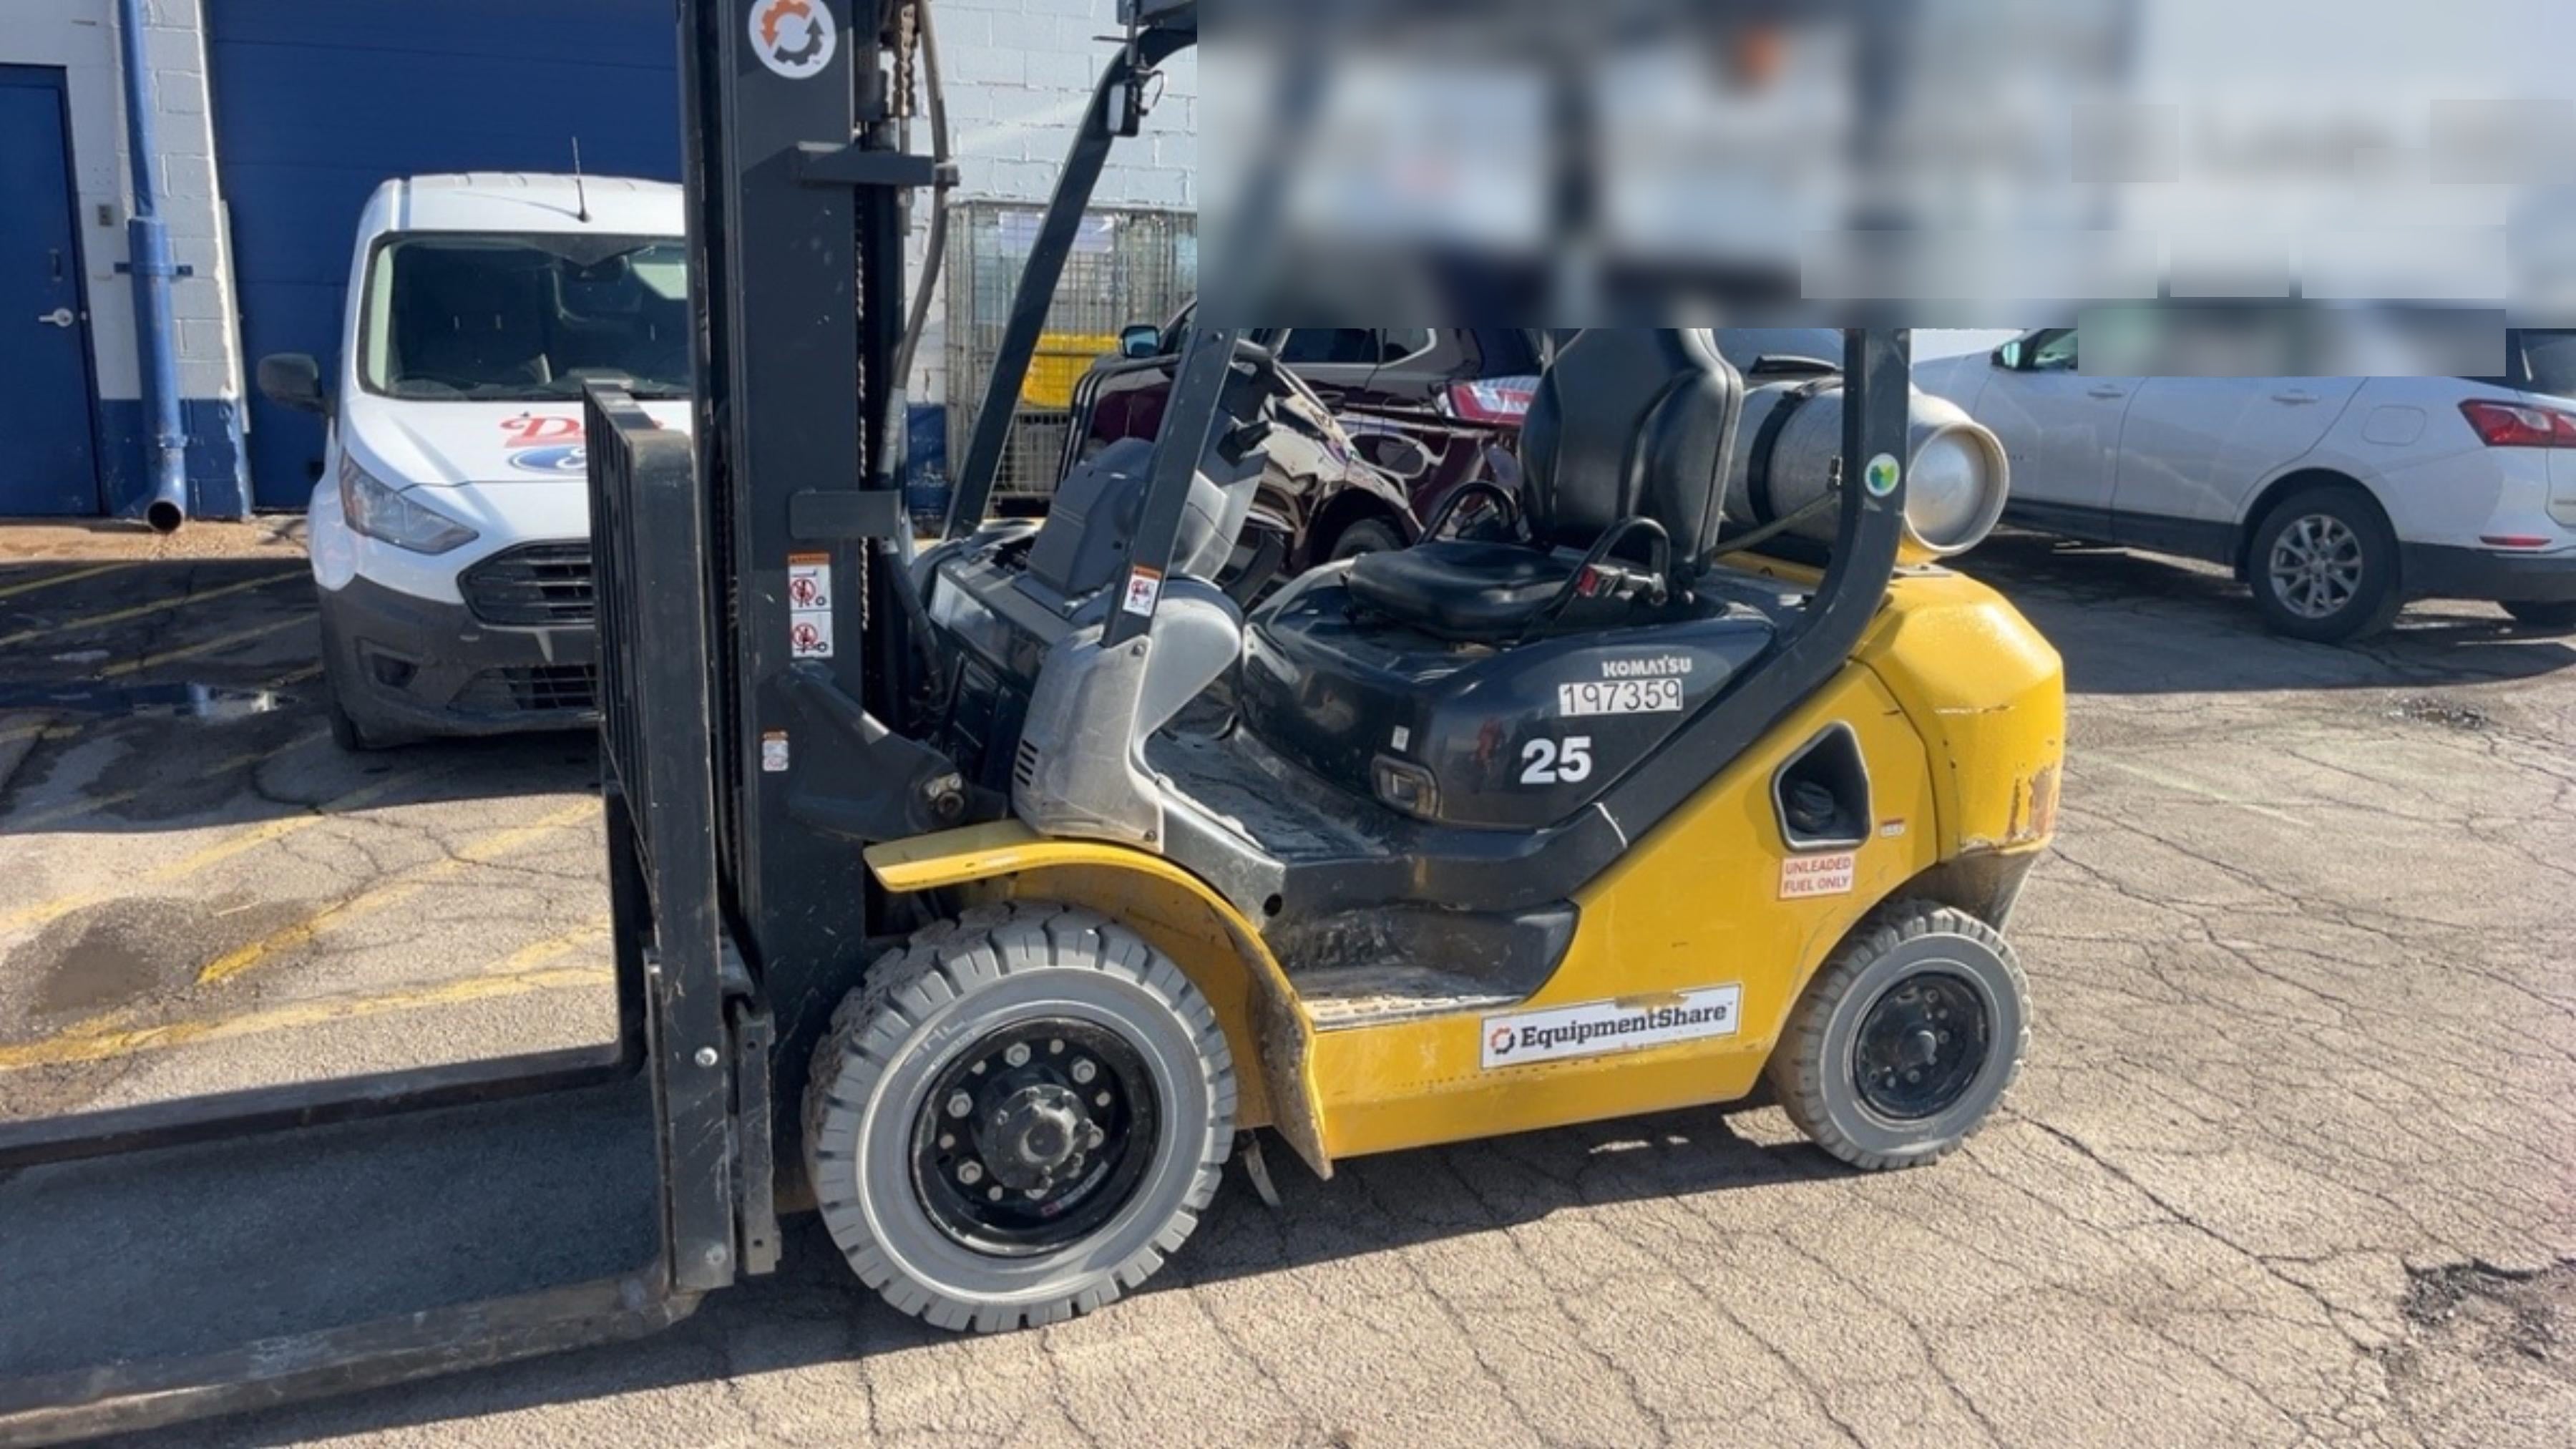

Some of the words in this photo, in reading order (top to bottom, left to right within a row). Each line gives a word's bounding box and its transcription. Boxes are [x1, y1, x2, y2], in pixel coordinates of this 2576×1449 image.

[1602, 655, 1692, 677] KOMATSU
[1564, 680, 1679, 713] 197359
[1520, 736, 1591, 784] 25
[1785, 857, 1851, 874] UNLEADED
[1784, 879, 1815, 892] FUEL
[1818, 875, 1850, 889] ONLY
[1520, 1005, 1727, 1049] EquipmentShare
